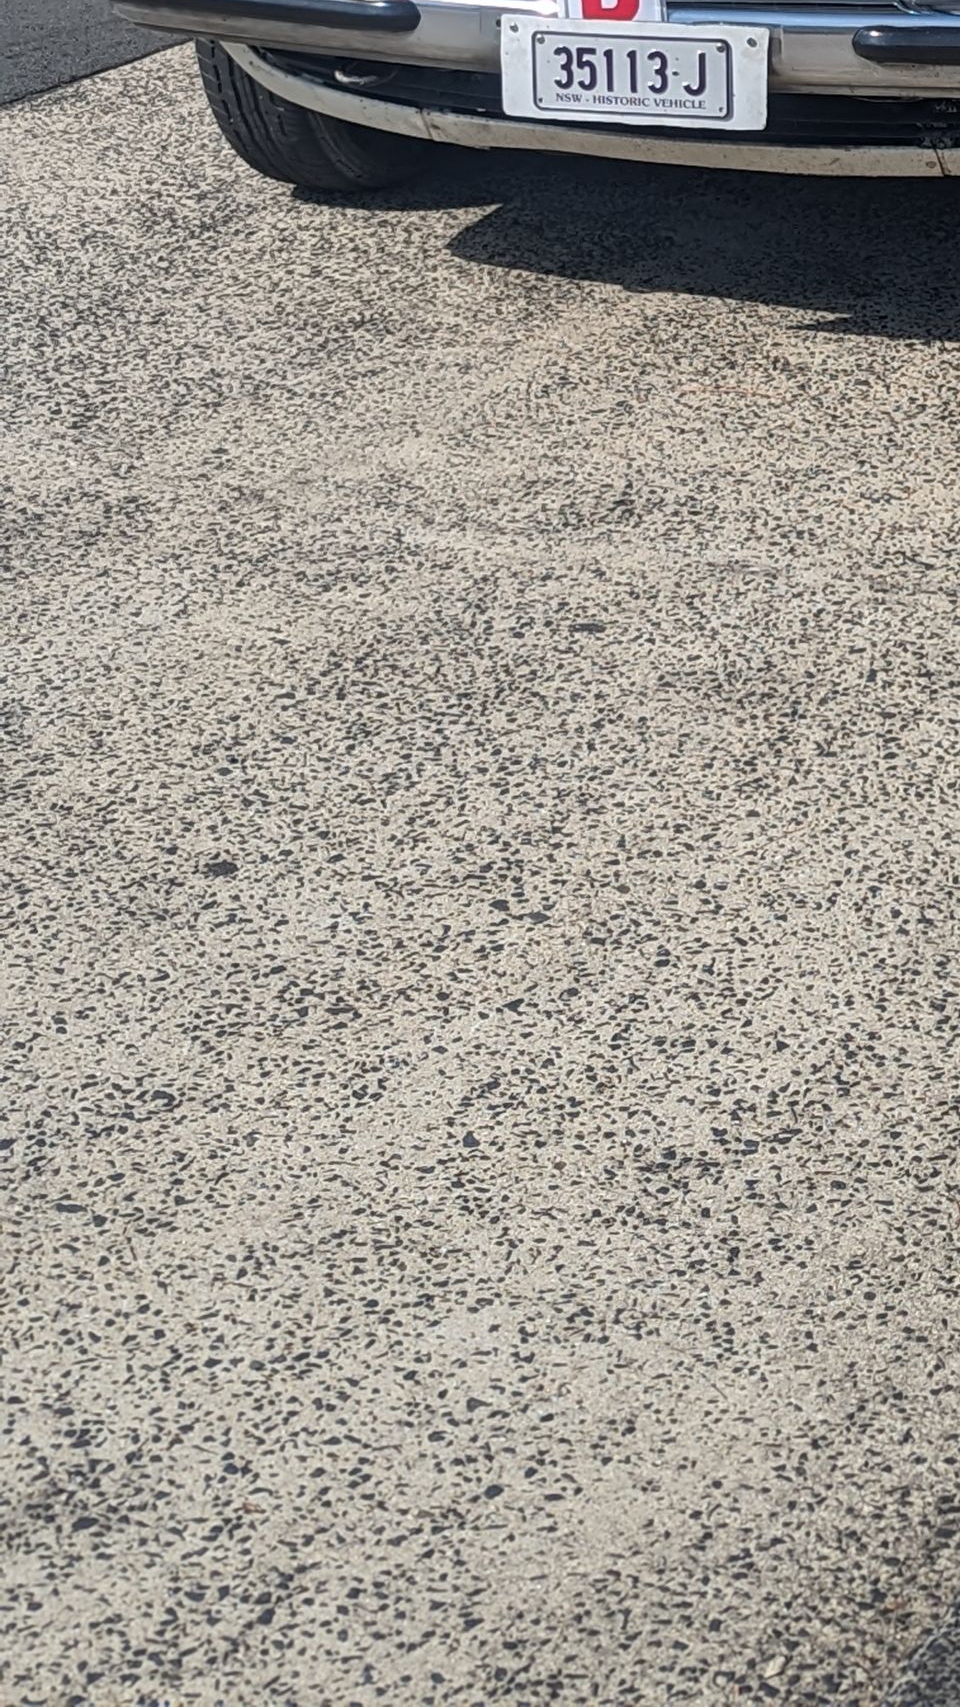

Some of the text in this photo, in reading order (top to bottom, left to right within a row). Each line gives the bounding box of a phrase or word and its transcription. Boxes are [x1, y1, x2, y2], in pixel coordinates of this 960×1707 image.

[555, 92, 583, 103] NSW
[592, 95, 650, 108] HISTORIC
[653, 98, 707, 110] VEHICLE
